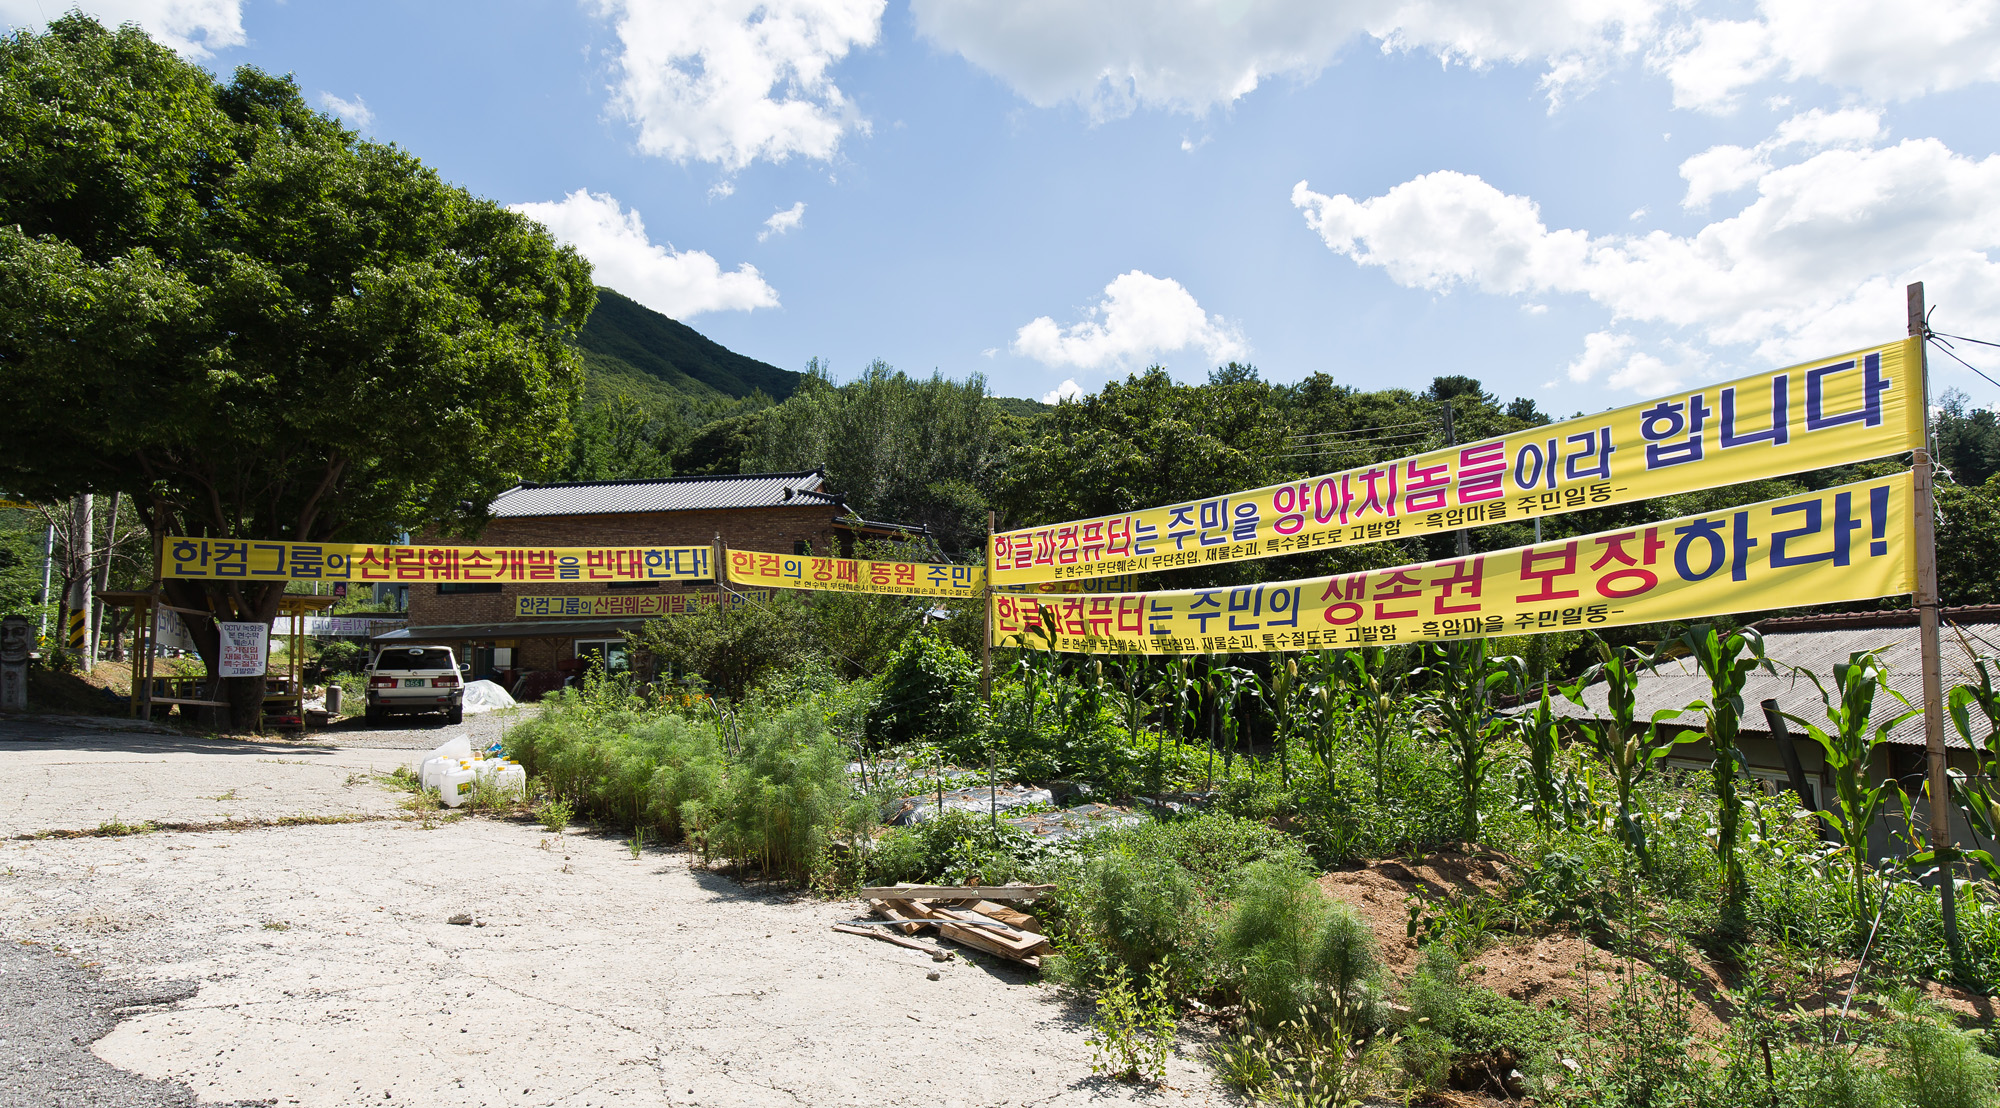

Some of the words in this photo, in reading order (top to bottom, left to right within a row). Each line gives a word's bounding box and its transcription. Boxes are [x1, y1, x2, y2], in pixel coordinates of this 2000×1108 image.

[994, 516, 1158, 571] 한글과컴퓨터는
[1168, 497, 1260, 550] 주민을
[1272, 425, 1616, 535] 양아치놈들이라
[1640, 350, 1892, 471] 합니다
[1055, 567, 1063, 578] 본
[1066, 564, 1094, 578] 현수막
[1097, 557, 1148, 573] 무단훼손시
[1152, 550, 1201, 568] 무단침입,
[1205, 542, 1261, 562] 재물손괴,
[1266, 529, 1342, 552] 특수절도로
[1349, 519, 1402, 541] 고발함
[1414, 501, 1507, 528] -흑암마을
[1517, 482, 1628, 514] 주민일동-
[172, 540, 352, 579] 한컴그룹의
[358, 547, 580, 580] 산림훼손개발을
[586, 548, 708, 579] 반대한다!
[732, 552, 802, 579] 한컴의
[811, 558, 858, 583] 깡패
[870, 562, 915, 586] 동원
[926, 565, 971, 588] 주민
[1187, 586, 1301, 634] 주민의
[1320, 555, 1485, 625] 생존권
[1515, 485, 1890, 604] 보장하라!
[793, 579, 801, 587] 본
[804, 581, 828, 589] 현수막
[519, 597, 592, 615] 한컴그룹의
[224, 624, 241, 632] CCTV
[228, 631, 236, 639] 본
[237, 631, 260, 639] 현수막
[1062, 637, 1070, 649] 본
[1072, 638, 1097, 651] 현수막
[1100, 639, 1148, 652] 무단훼손시
[1151, 637, 1199, 652] 무단침입,
[1201, 635, 1258, 650] 재물손괴,
[1261, 629, 1338, 648] 특수절도로
[1345, 624, 1398, 642] 고발함
[1410, 615, 1505, 638] -흑암마을
[1514, 604, 1625, 630] 주민일동-
